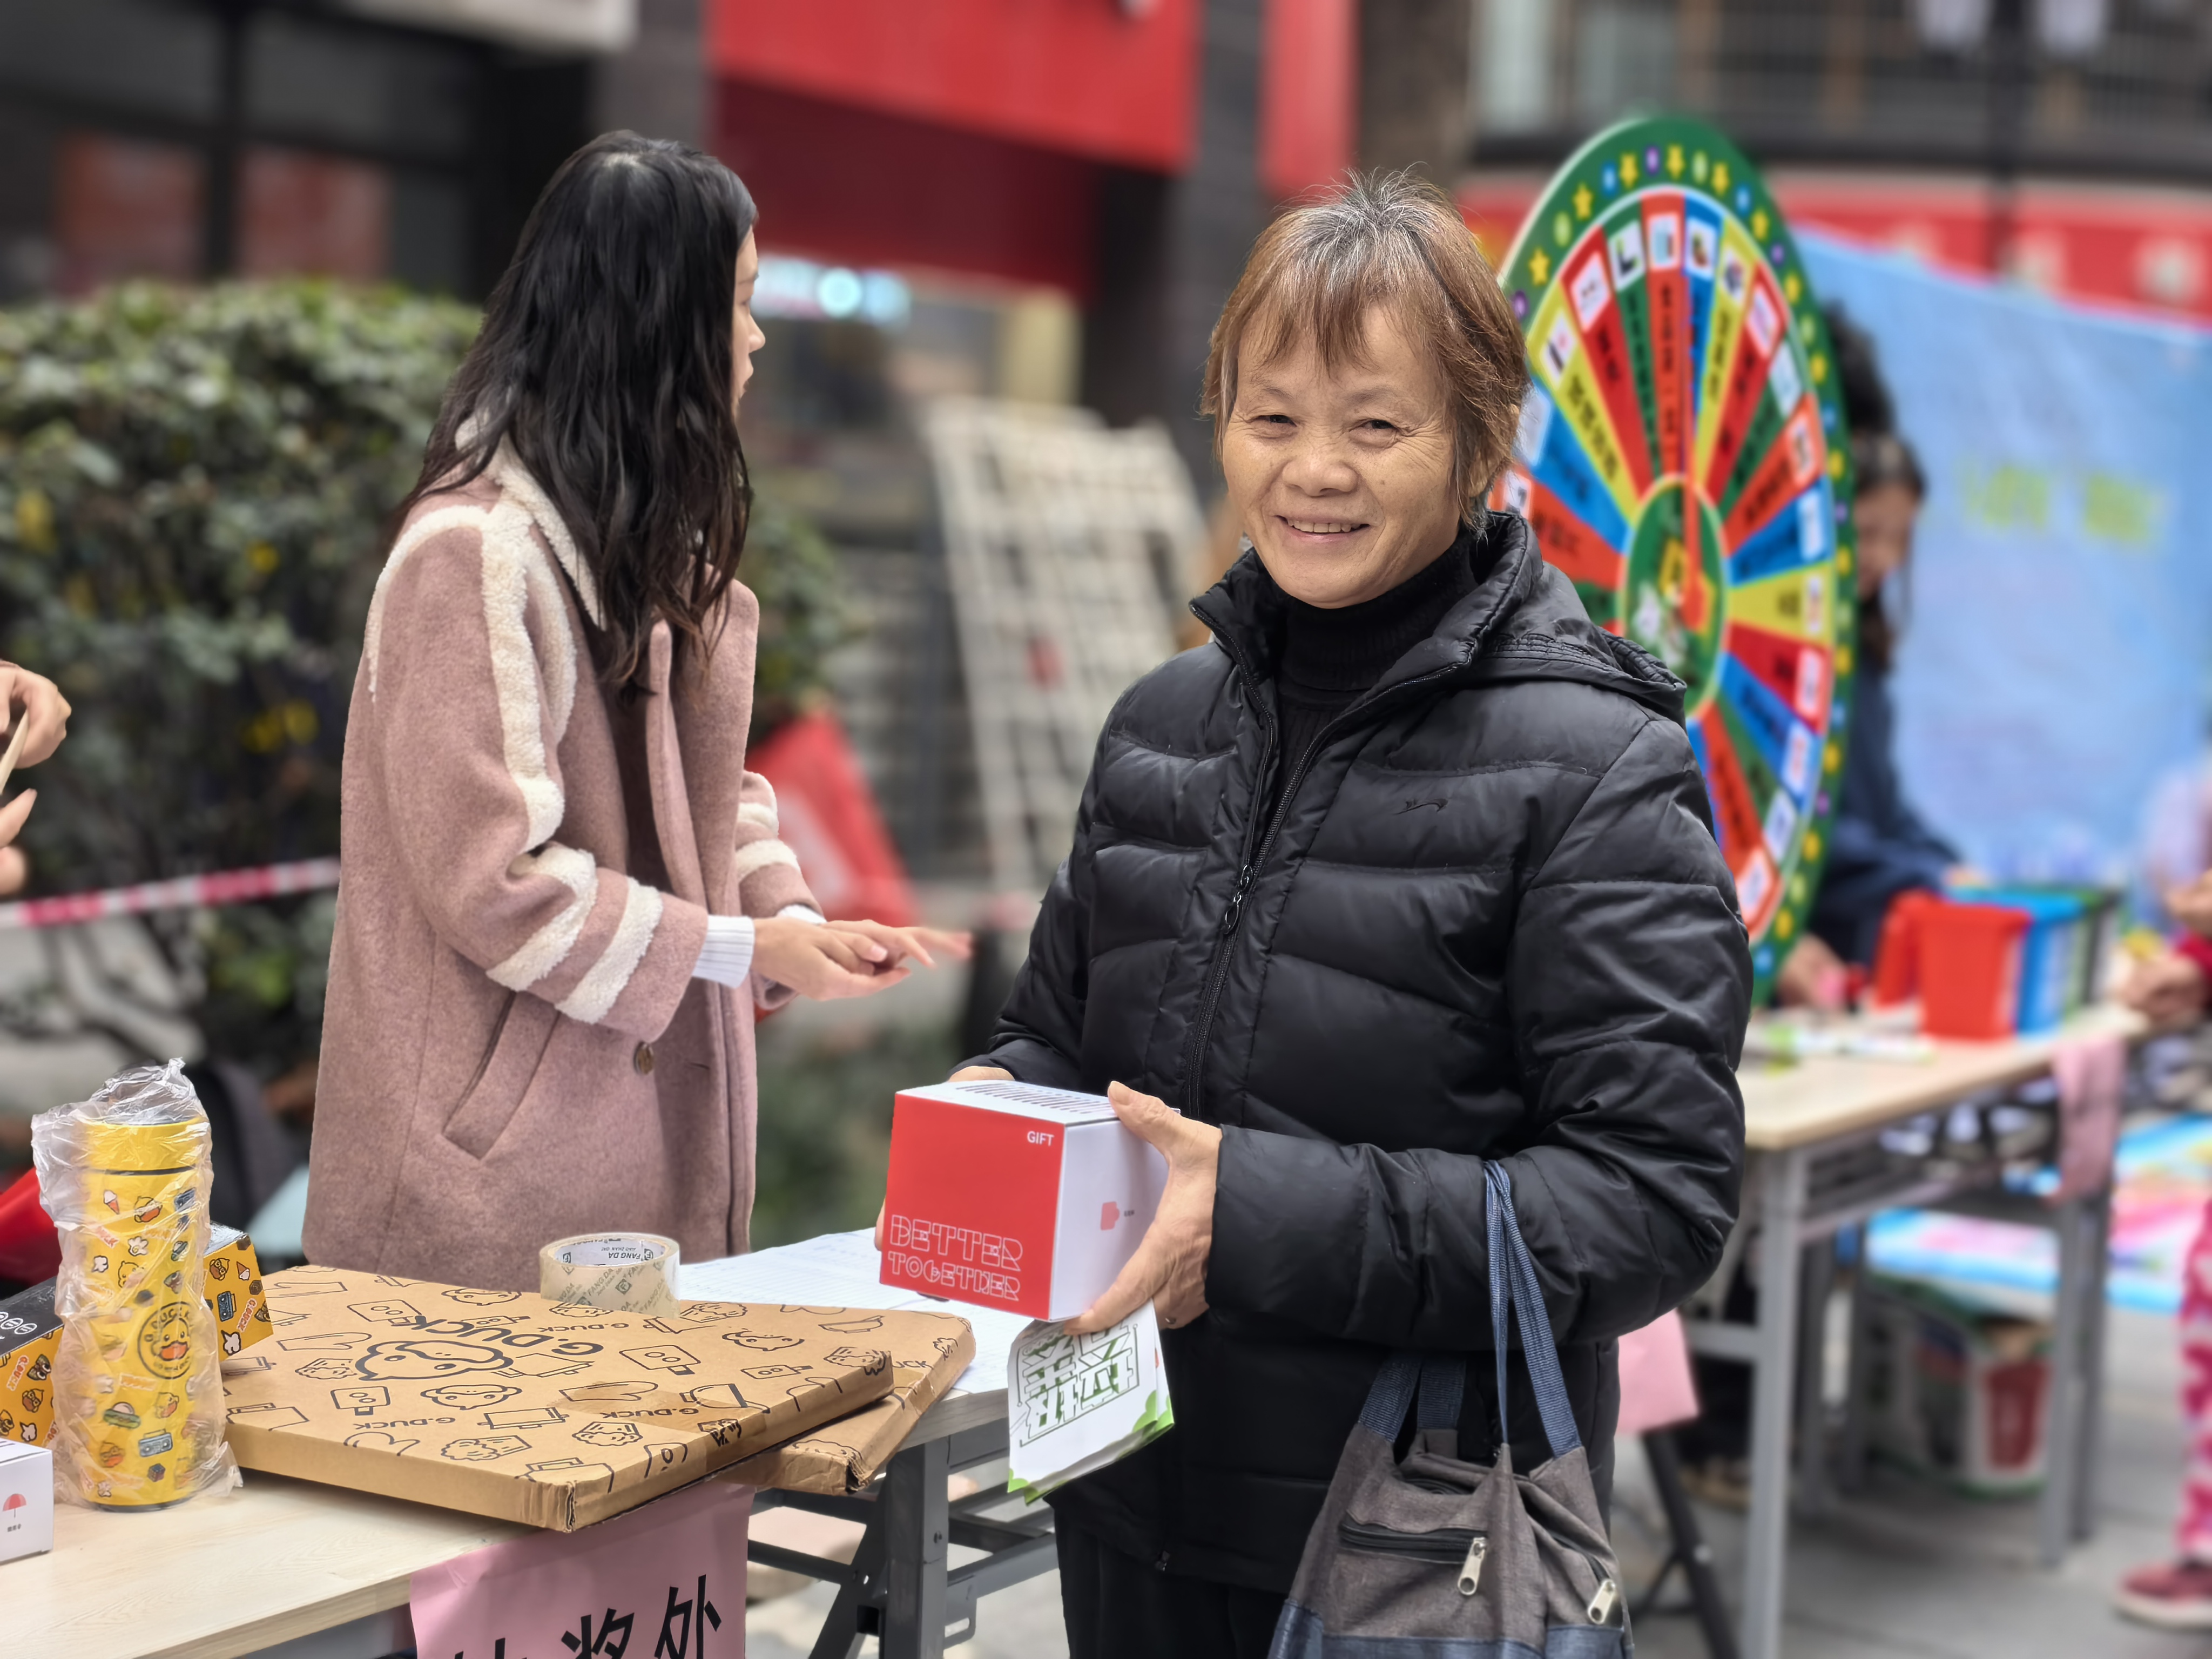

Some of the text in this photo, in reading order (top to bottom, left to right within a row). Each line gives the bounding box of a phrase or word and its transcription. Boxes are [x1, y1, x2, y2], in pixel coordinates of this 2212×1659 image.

[1027, 1131, 1054, 1146] GIFT
[890, 1214, 1023, 1272] BETTER
[888, 1251, 1021, 1301] TOGETHER
[411, 1315, 604, 1355] G.DUCK
[537, 1323, 629, 1332] G.DUCK
[599, 1407, 699, 1419] G.DUCK
[353, 1417, 456, 1429] G.DUCK
